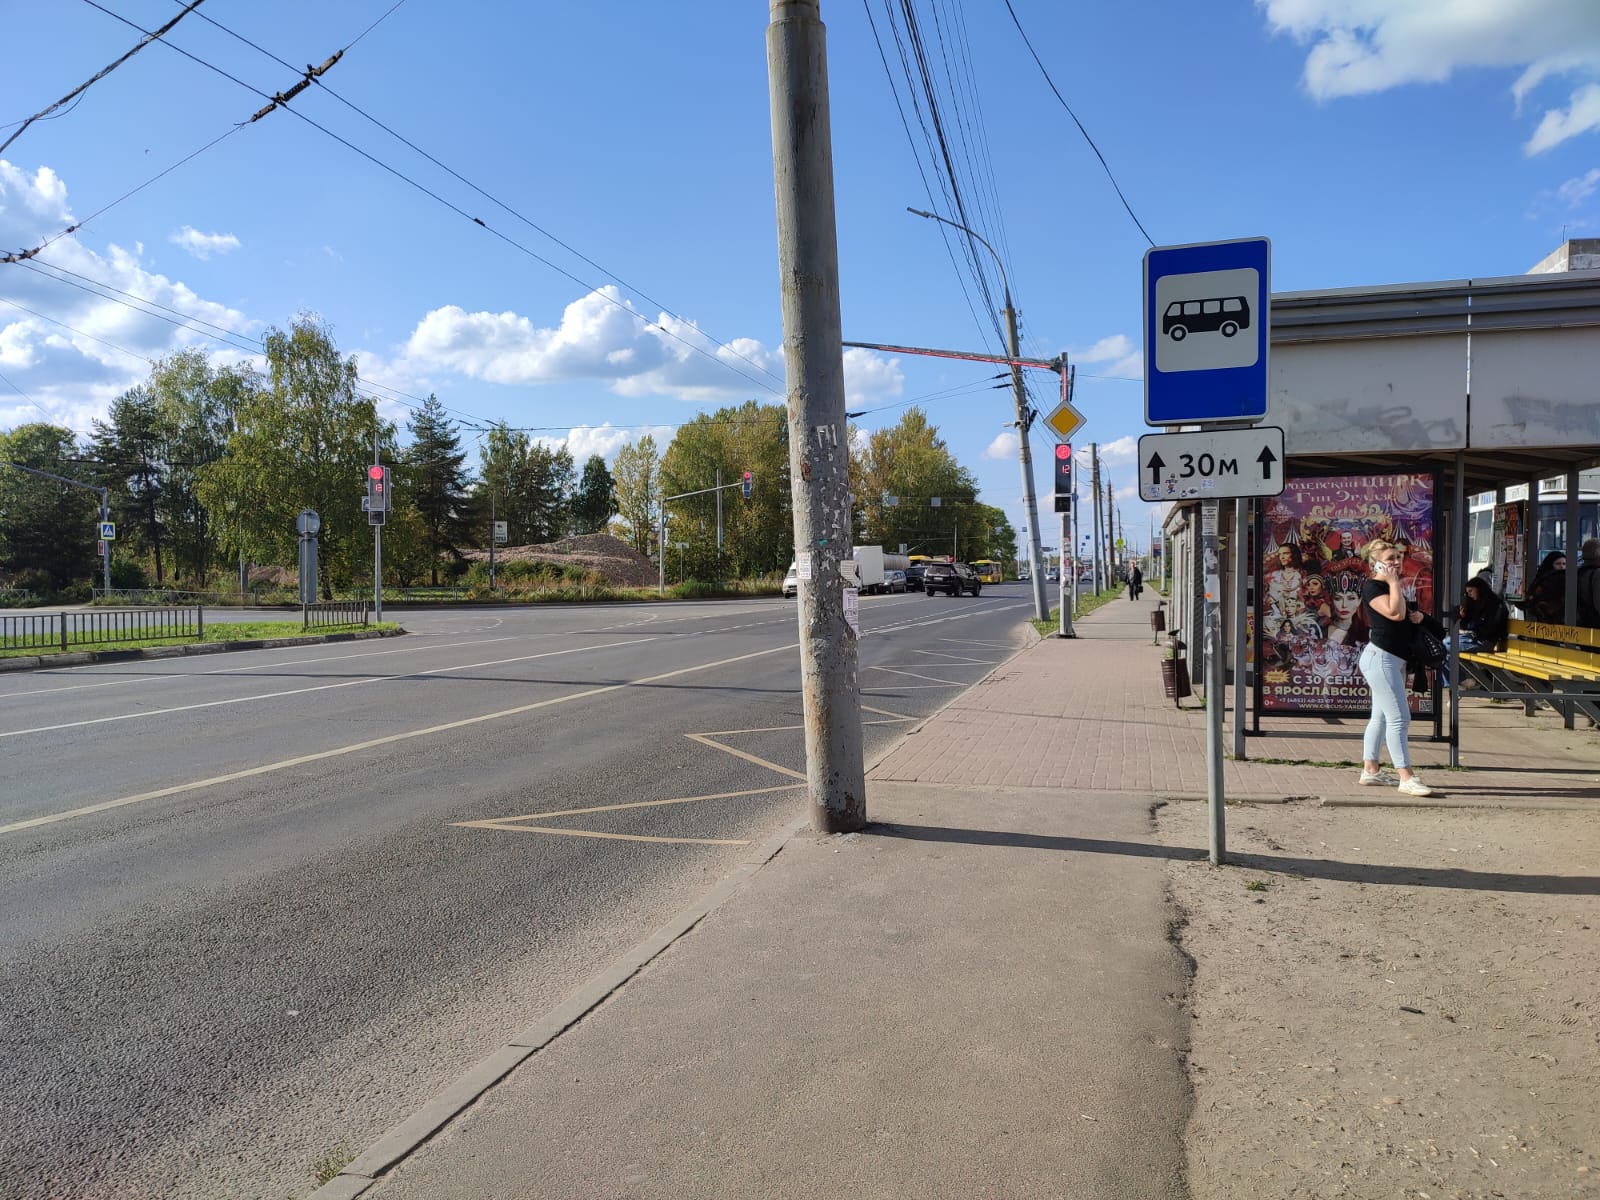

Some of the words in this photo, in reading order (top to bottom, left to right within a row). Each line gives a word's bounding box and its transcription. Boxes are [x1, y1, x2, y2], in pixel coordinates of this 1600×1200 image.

[1285, 481, 1358, 490] РОЛЕВСКИЙ
[1292, 676, 1302, 684] С
[1305, 676, 1321, 685] 30
[1263, 686, 1271, 695] В
